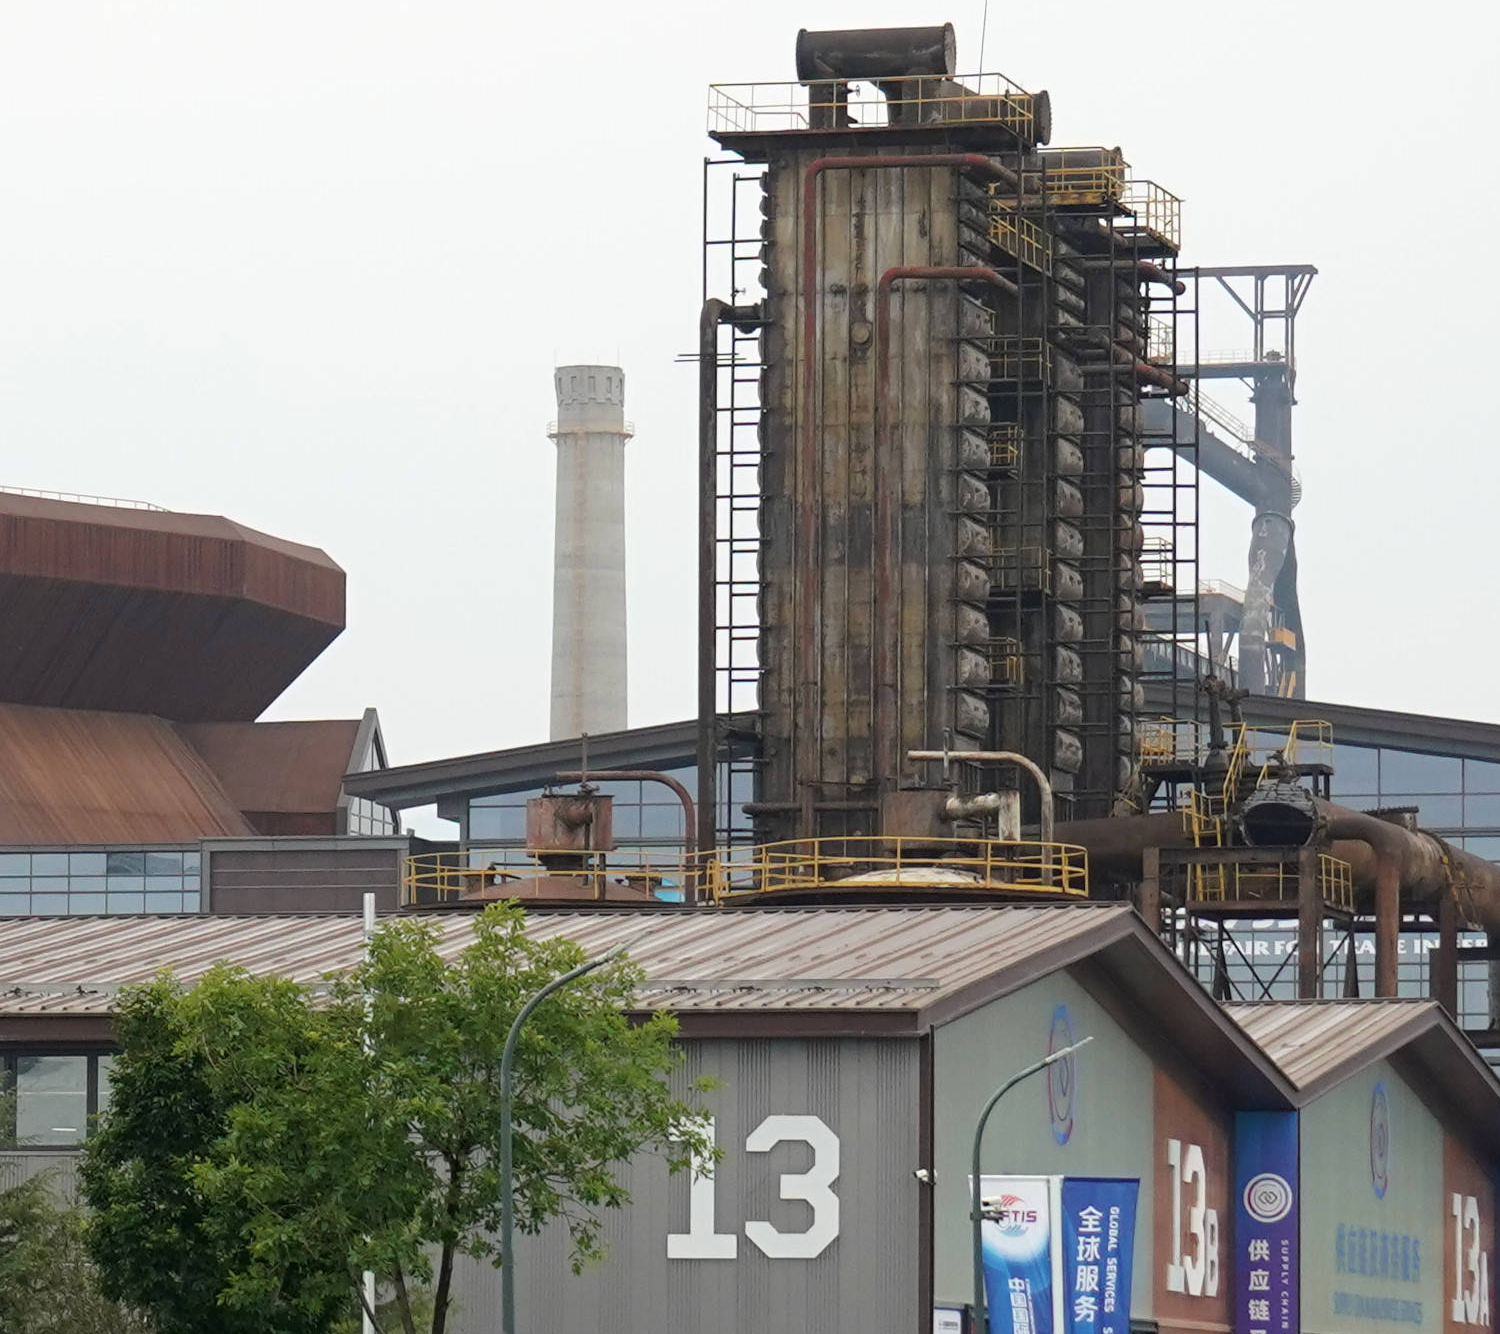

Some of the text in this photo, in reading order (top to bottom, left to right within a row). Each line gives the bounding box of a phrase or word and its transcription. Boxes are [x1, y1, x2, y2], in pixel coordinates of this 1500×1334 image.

[667, 1114, 840, 1259] 13
[1106, 1207, 1120, 1252] GLOBAL
[1167, 1138, 1219, 1298] 13B
[1074, 1205, 1103, 1324] 全球服务
[1103, 1258, 1117, 1314] SERVICES
[1280, 1239, 1289, 1285] SUPPLY
[1280, 1291, 1289, 1329] CHAIN
